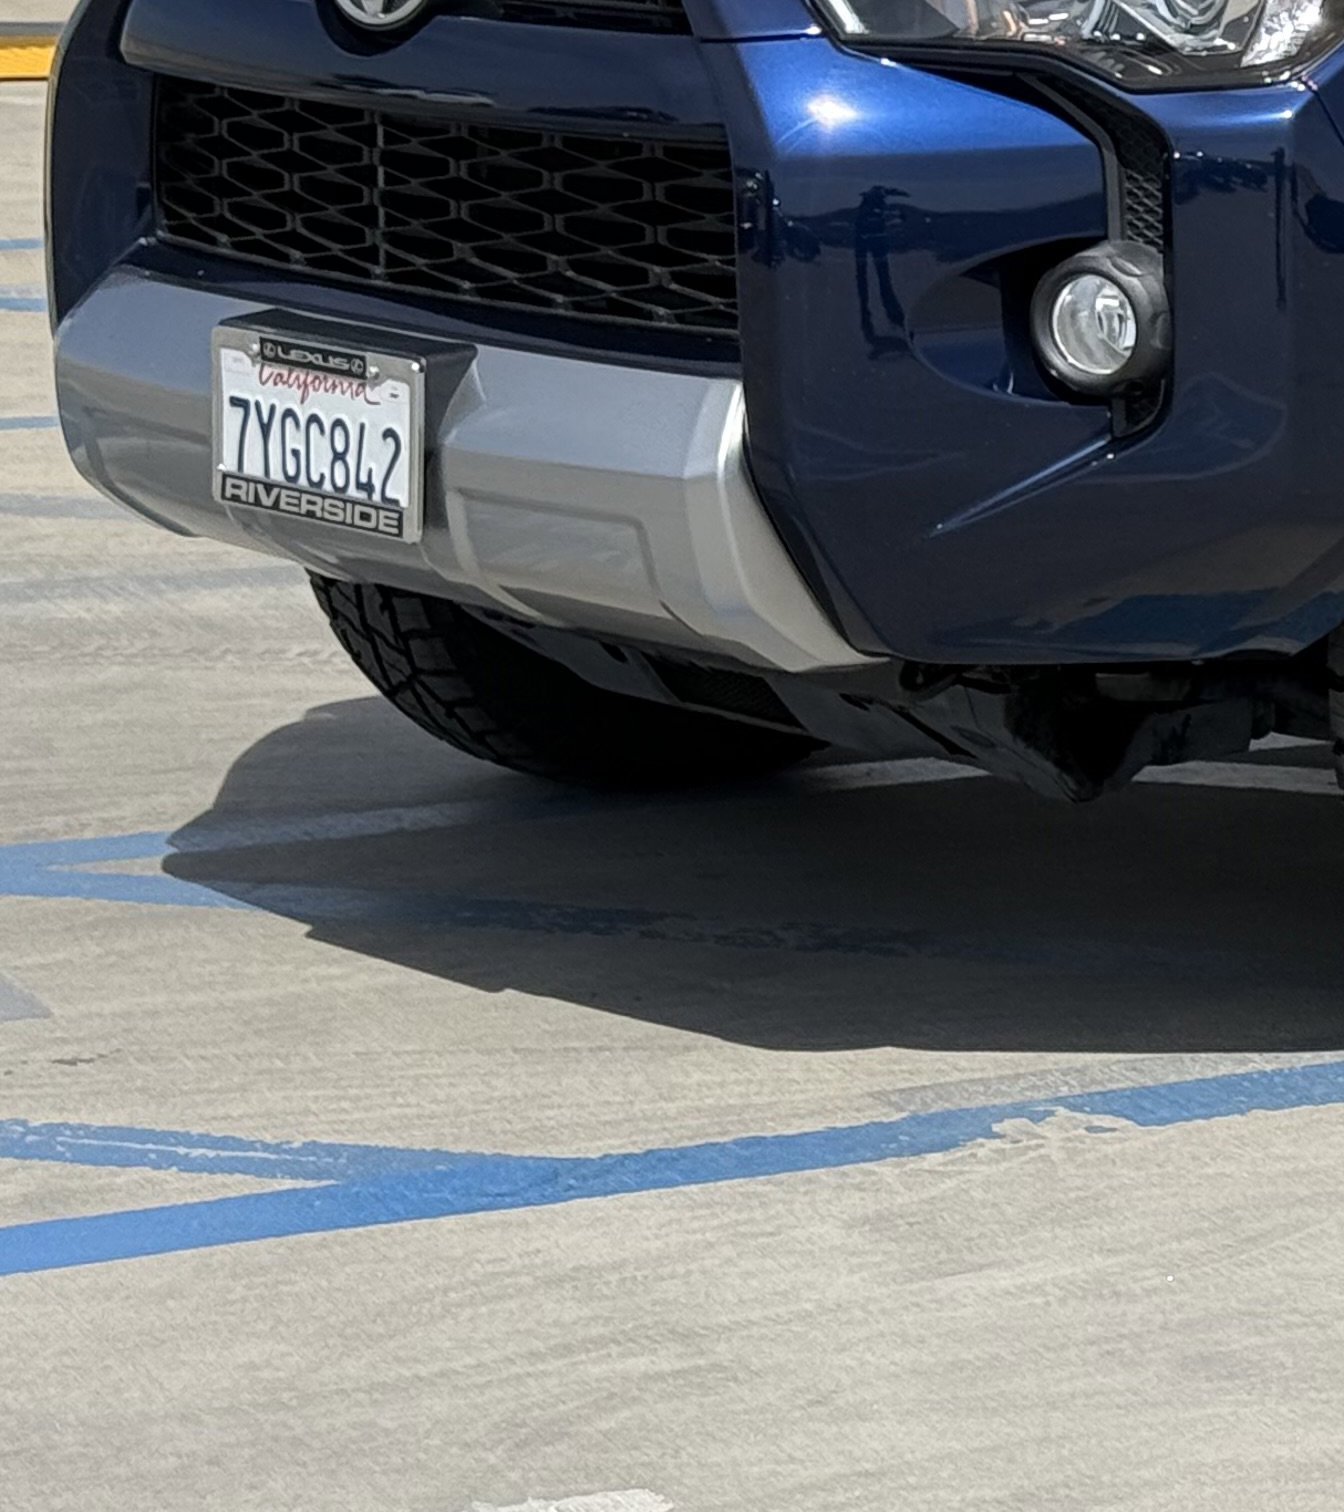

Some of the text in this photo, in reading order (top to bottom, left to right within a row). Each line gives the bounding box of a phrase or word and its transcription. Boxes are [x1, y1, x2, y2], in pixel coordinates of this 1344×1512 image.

[258, 362, 382, 406] California
[276, 345, 351, 371] LEXUS
[229, 395, 402, 507] 7YGC842
[224, 476, 400, 536] RIVERSIDE
